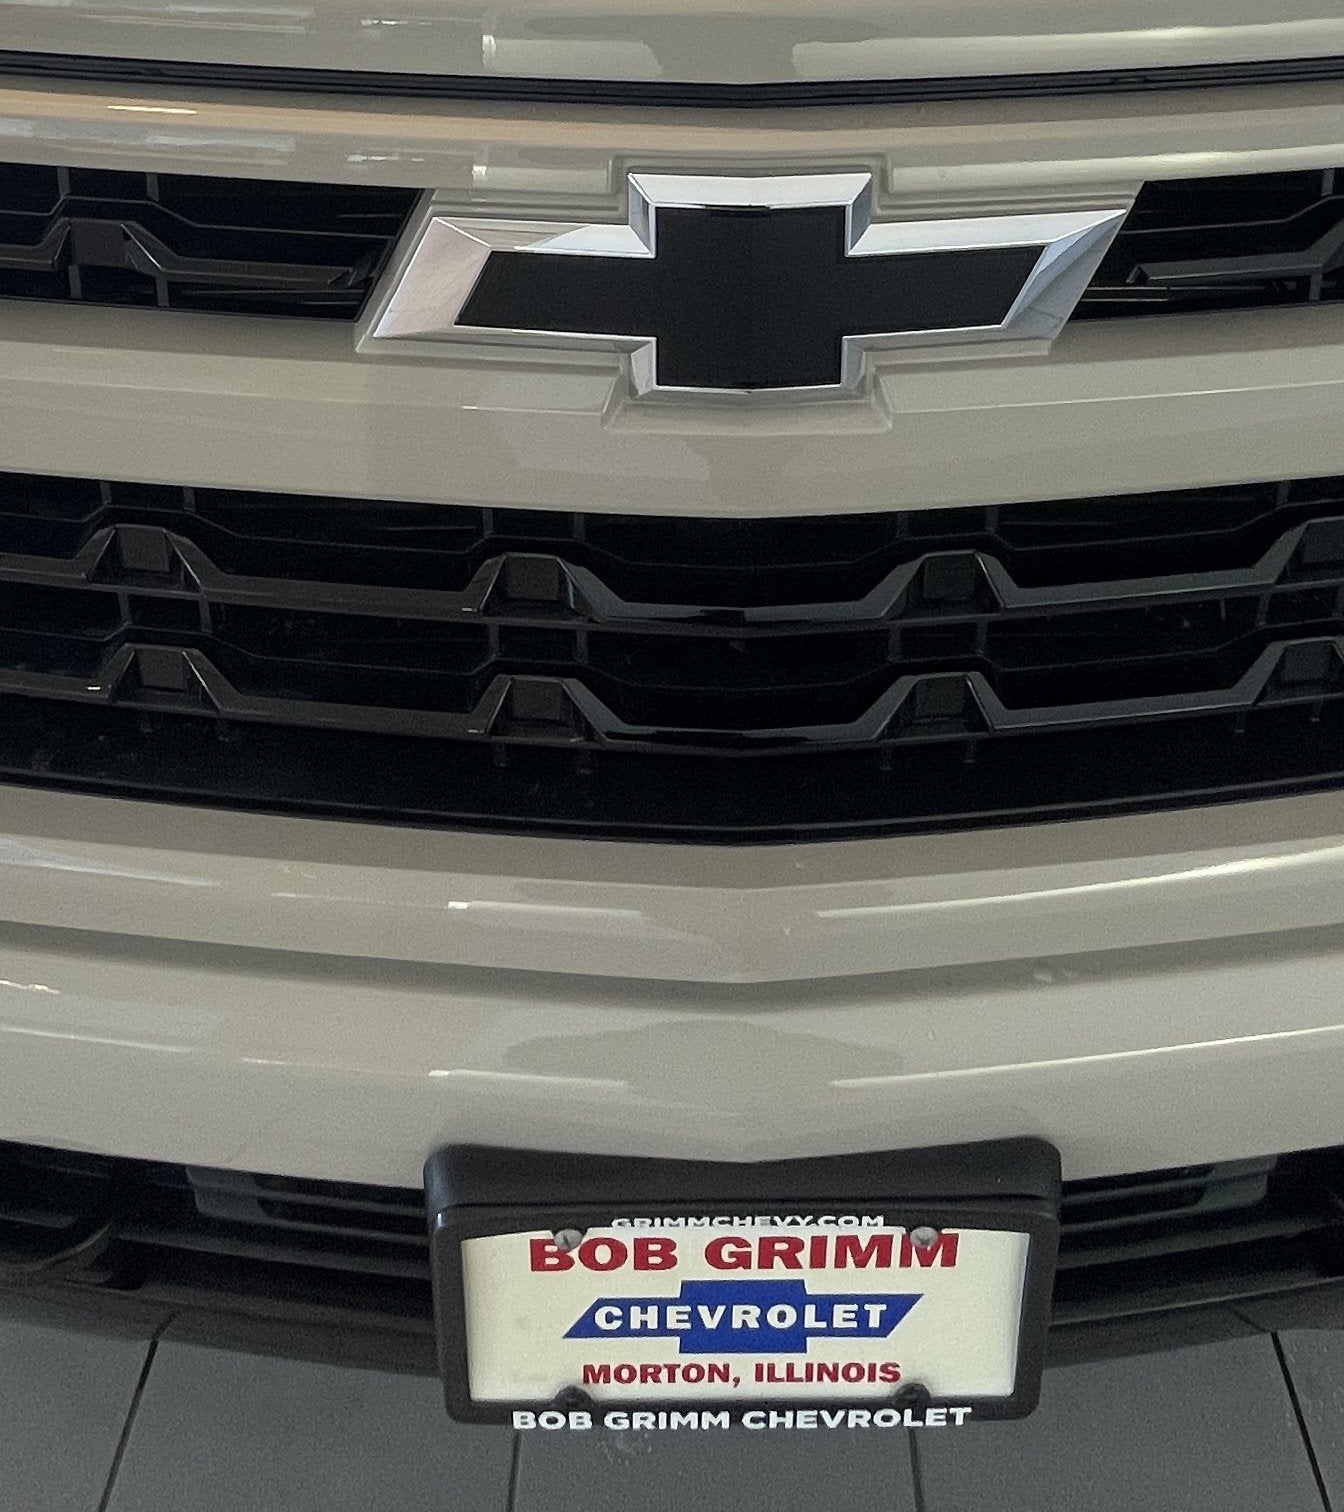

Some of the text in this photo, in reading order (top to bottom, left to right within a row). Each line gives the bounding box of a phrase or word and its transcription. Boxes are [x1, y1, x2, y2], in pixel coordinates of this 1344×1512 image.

[611, 1215, 885, 1228] GRIMMCHEVY.COM
[529, 1233, 959, 1272] BOB GRIMM
[594, 1304, 887, 1331] CHEVROLET
[582, 1361, 901, 1388] MORTON, ILLINOIS
[512, 1406, 973, 1431] BOB GRIMM CHEVROLET
